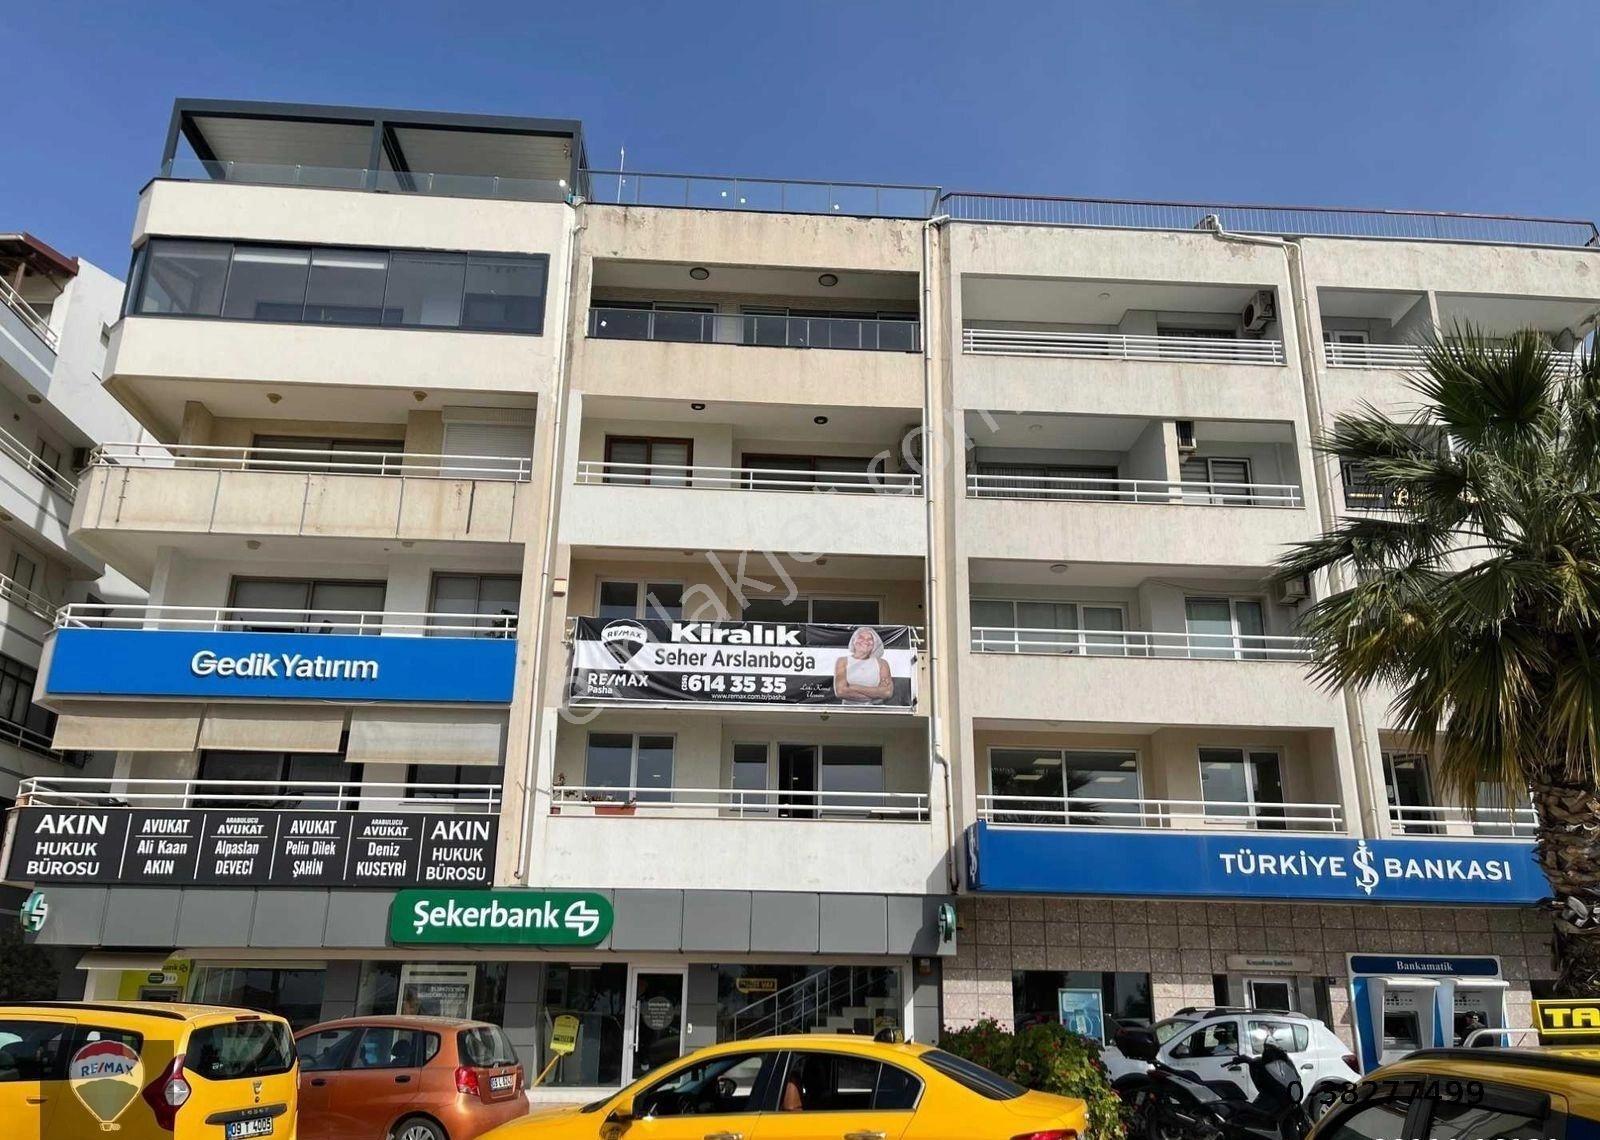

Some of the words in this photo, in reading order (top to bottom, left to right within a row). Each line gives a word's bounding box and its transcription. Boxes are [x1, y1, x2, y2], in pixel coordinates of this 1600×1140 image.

[607, 631, 642, 639] RE/MAX
[671, 622, 801, 646] Kiralık
[191, 650, 280, 677] Gedik
[282, 653, 379, 679] Yatırım
[654, 648, 707, 666] Seher
[711, 650, 816, 672] Arslanboğa
[587, 673, 649, 687] RE/MAX
[690, 675, 725, 693] 614
[730, 676, 756, 693] 35
[761, 677, 787, 694] 35
[587, 685, 613, 695] Pasha
[34, 814, 108, 835] AKIN
[142, 819, 190, 833] AVUKAT
[217, 824, 265, 834] AVUKAT
[290, 820, 337, 834] AVUKAT
[363, 826, 409, 836] AVUKAT
[431, 820, 490, 841] AKIN
[35, 842, 98, 856] HUKUK
[137, 840, 154, 854] Ali
[158, 840, 188, 854] Kaan
[215, 841, 259, 857] Alpaslan
[285, 841, 309, 855] Pelin
[312, 841, 336, 855] Dilek
[368, 842, 400, 856] Deniz
[432, 847, 483, 861] HUKUK
[26, 858, 100, 875] BÜROSU
[143, 860, 175, 874] AKIN
[215, 858, 254, 874] DEVECİ
[292, 858, 323, 877] ŞAHİN
[356, 860, 407, 876] KUSEYRİ
[426, 864, 486, 881] BÜROSU
[1219, 849, 1347, 876] TÜRKİYE
[1384, 858, 1512, 881] BANKASI
[413, 899, 560, 935] Şekerbank
[1396, 961, 1453, 971] Bankamatik
[231, 1122, 241, 1135] 09
[245, 1121, 250, 1133] T
[253, 1118, 271, 1131] 4005
